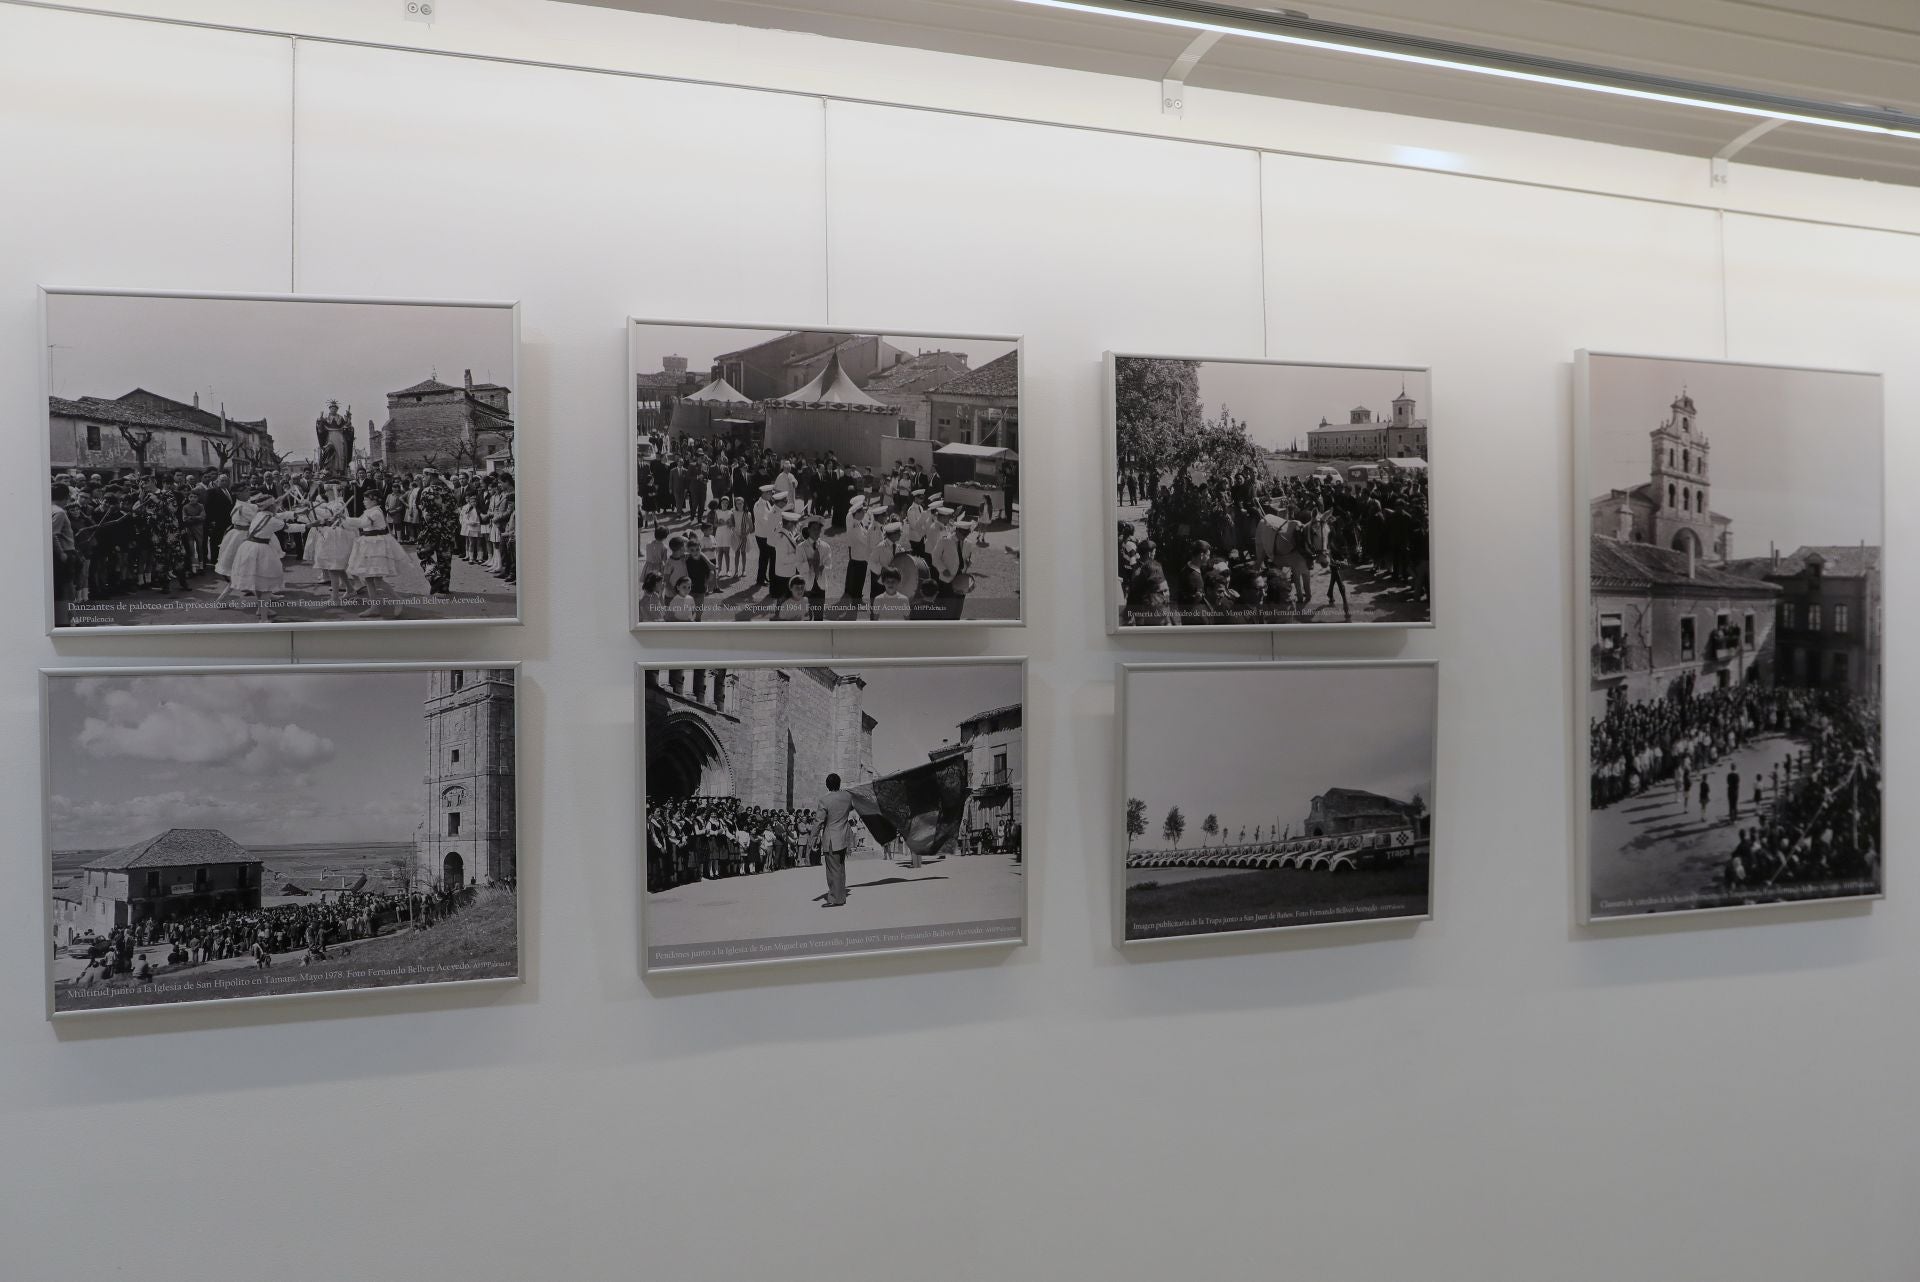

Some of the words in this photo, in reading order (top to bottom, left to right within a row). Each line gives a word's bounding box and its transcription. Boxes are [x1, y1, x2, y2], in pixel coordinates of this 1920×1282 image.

[67, 602, 115, 611] Danzantes
[116, 601, 127, 611] de
[163, 601, 174, 609] en
[175, 600, 184, 610] la
[228, 599, 239, 609] de
[240, 599, 256, 608] San
[259, 599, 285, 608] Telmo
[286, 600, 297, 608] en
[362, 598, 380, 606] Foto
[382, 596, 421, 606] Fernando
[823, 602, 856, 611] Fernando
[690, 949, 711, 960] junto
[759, 943, 773, 952] San
[67, 988, 110, 999] Multitud
[110, 986, 135, 997] junto
[143, 984, 152, 993] la
[153, 982, 182, 993] Iglesia
[183, 980, 194, 990] de
[195, 980, 212, 989] San
[251, 977, 262, 986] en
[299, 973, 323, 983] Mayo
[346, 969, 366, 978] Foto
[367, 966, 406, 977] Fernando
[407, 963, 435, 974] Bellver
